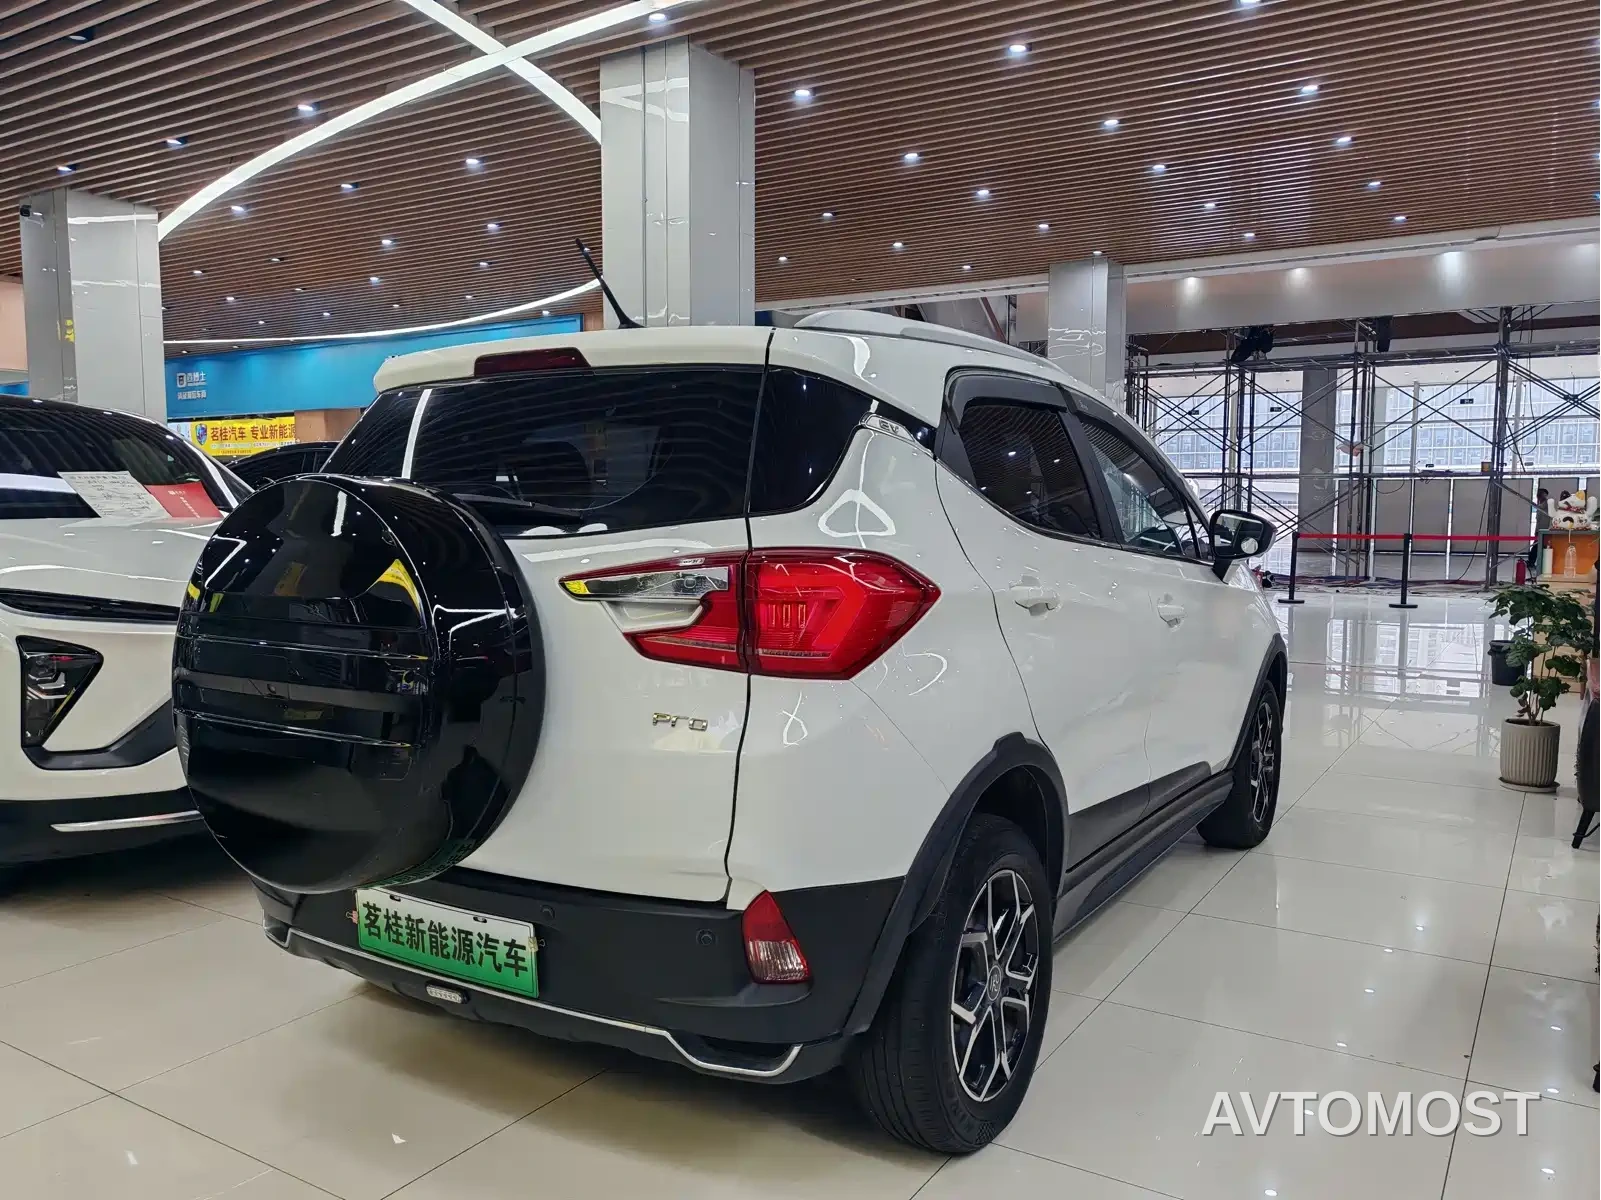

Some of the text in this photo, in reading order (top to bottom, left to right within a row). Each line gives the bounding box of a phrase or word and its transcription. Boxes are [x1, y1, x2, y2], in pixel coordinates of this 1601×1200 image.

[210, 426, 247, 441] 茗桂汽车
[879, 419, 900, 434] EV
[362, 901, 529, 978] 茗桂新能源汽车
